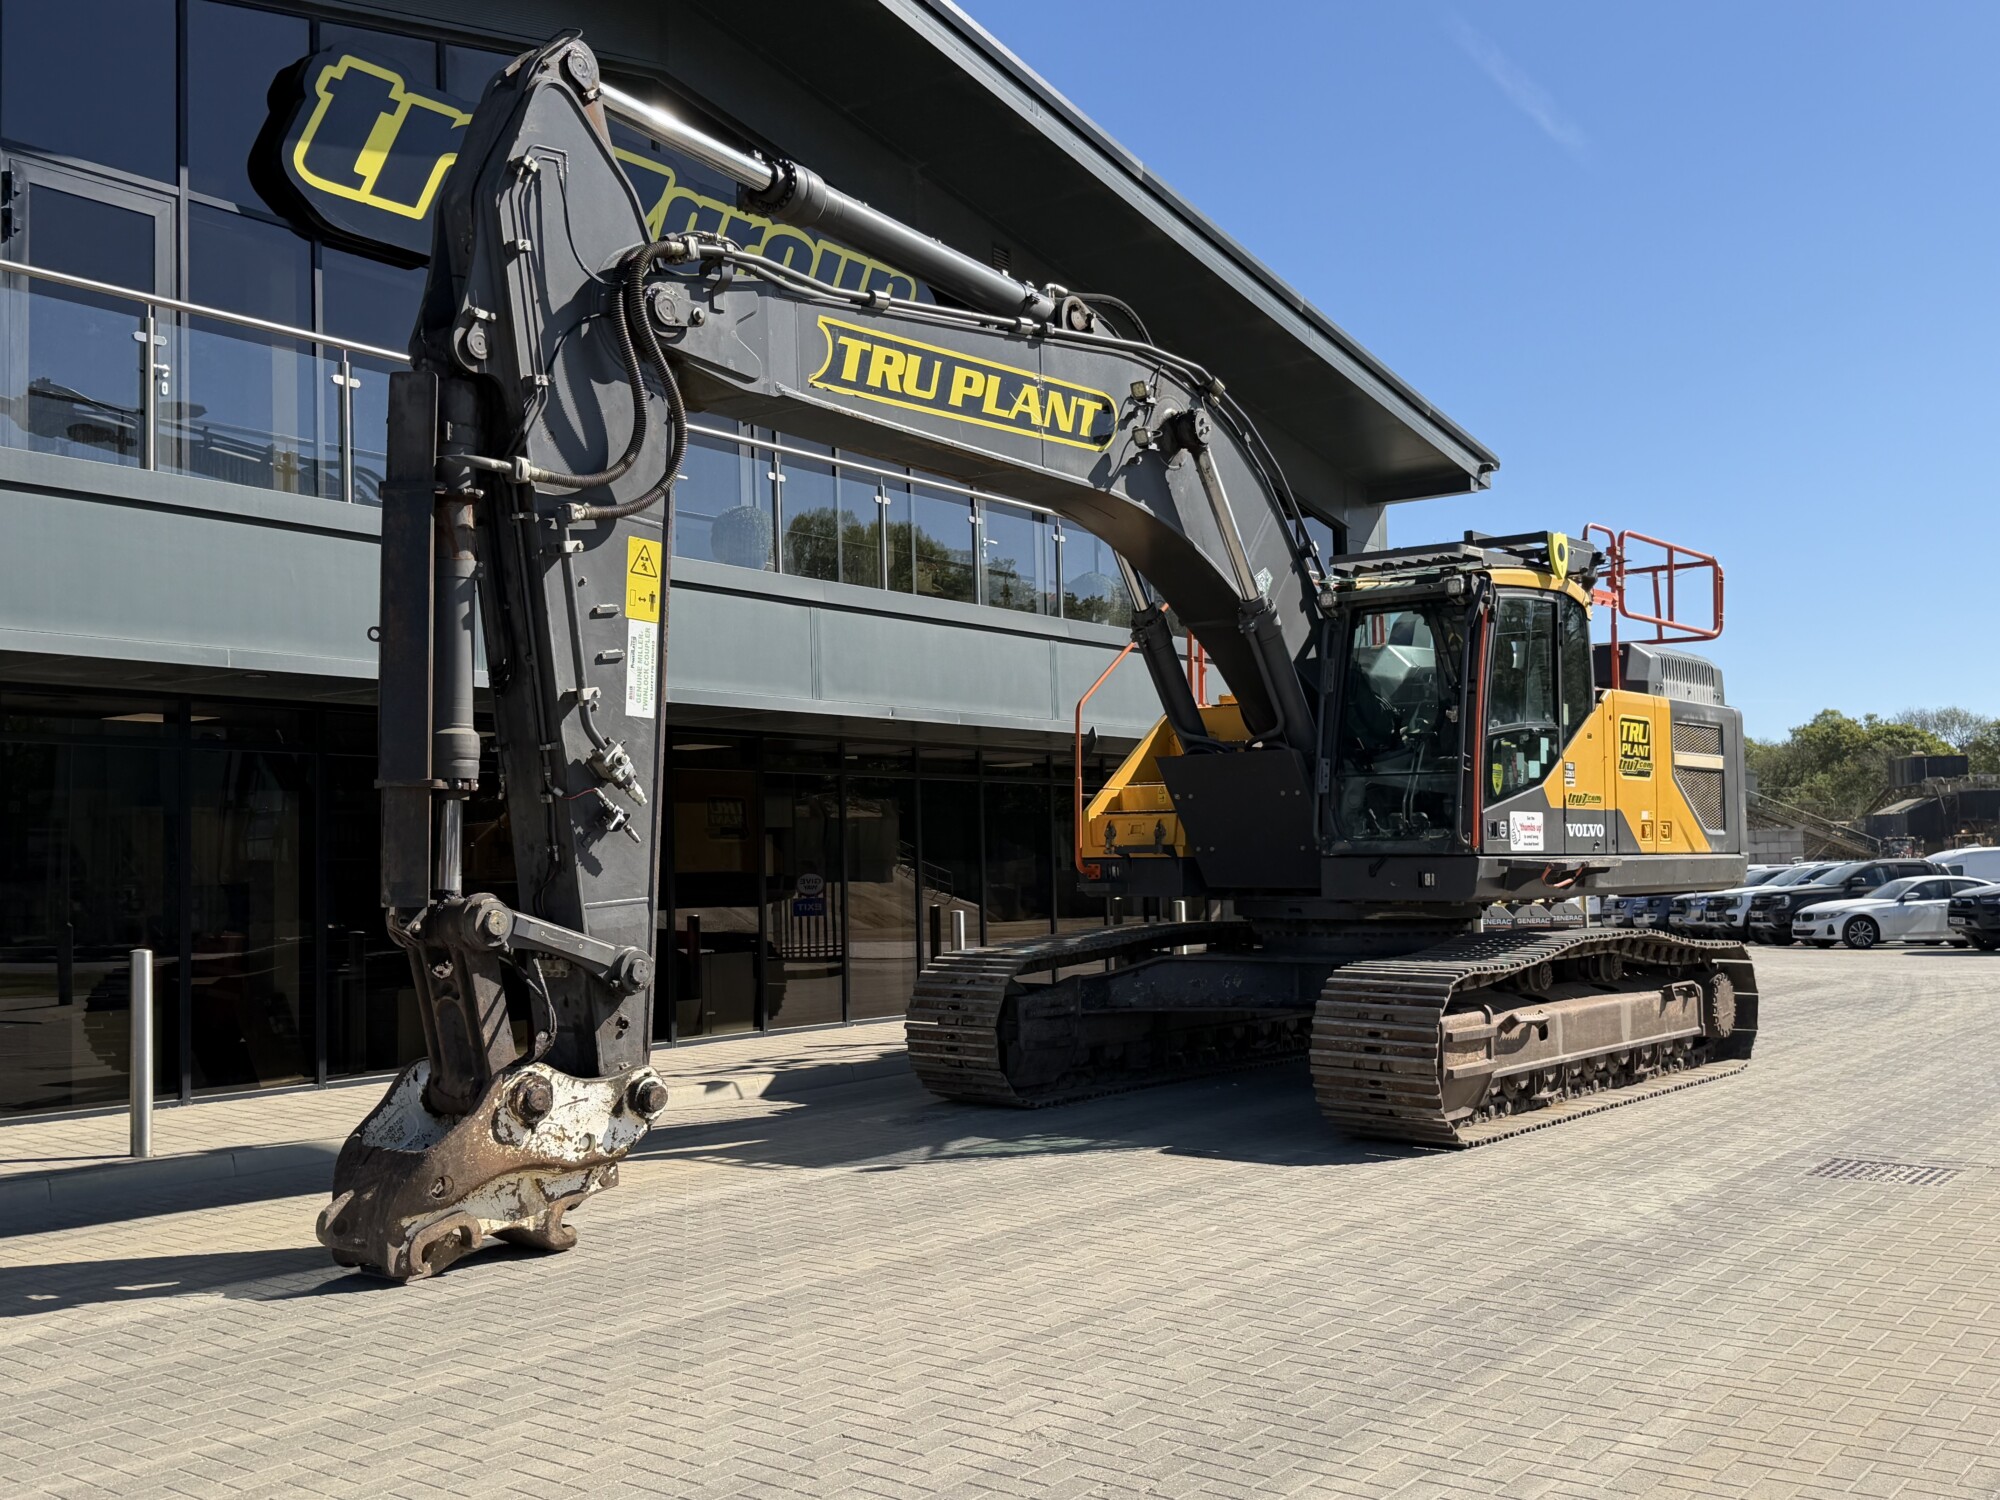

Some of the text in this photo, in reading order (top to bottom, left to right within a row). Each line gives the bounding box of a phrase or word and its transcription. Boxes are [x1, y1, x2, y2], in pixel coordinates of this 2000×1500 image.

[837, 335, 1103, 437] TRU PLANT
[642, 627, 651, 712] TWINLOCK COUPLER
[1621, 721, 1650, 743] TRU
[1621, 743, 1650, 757] PLANT
[1566, 823, 1605, 838] VOLVO
